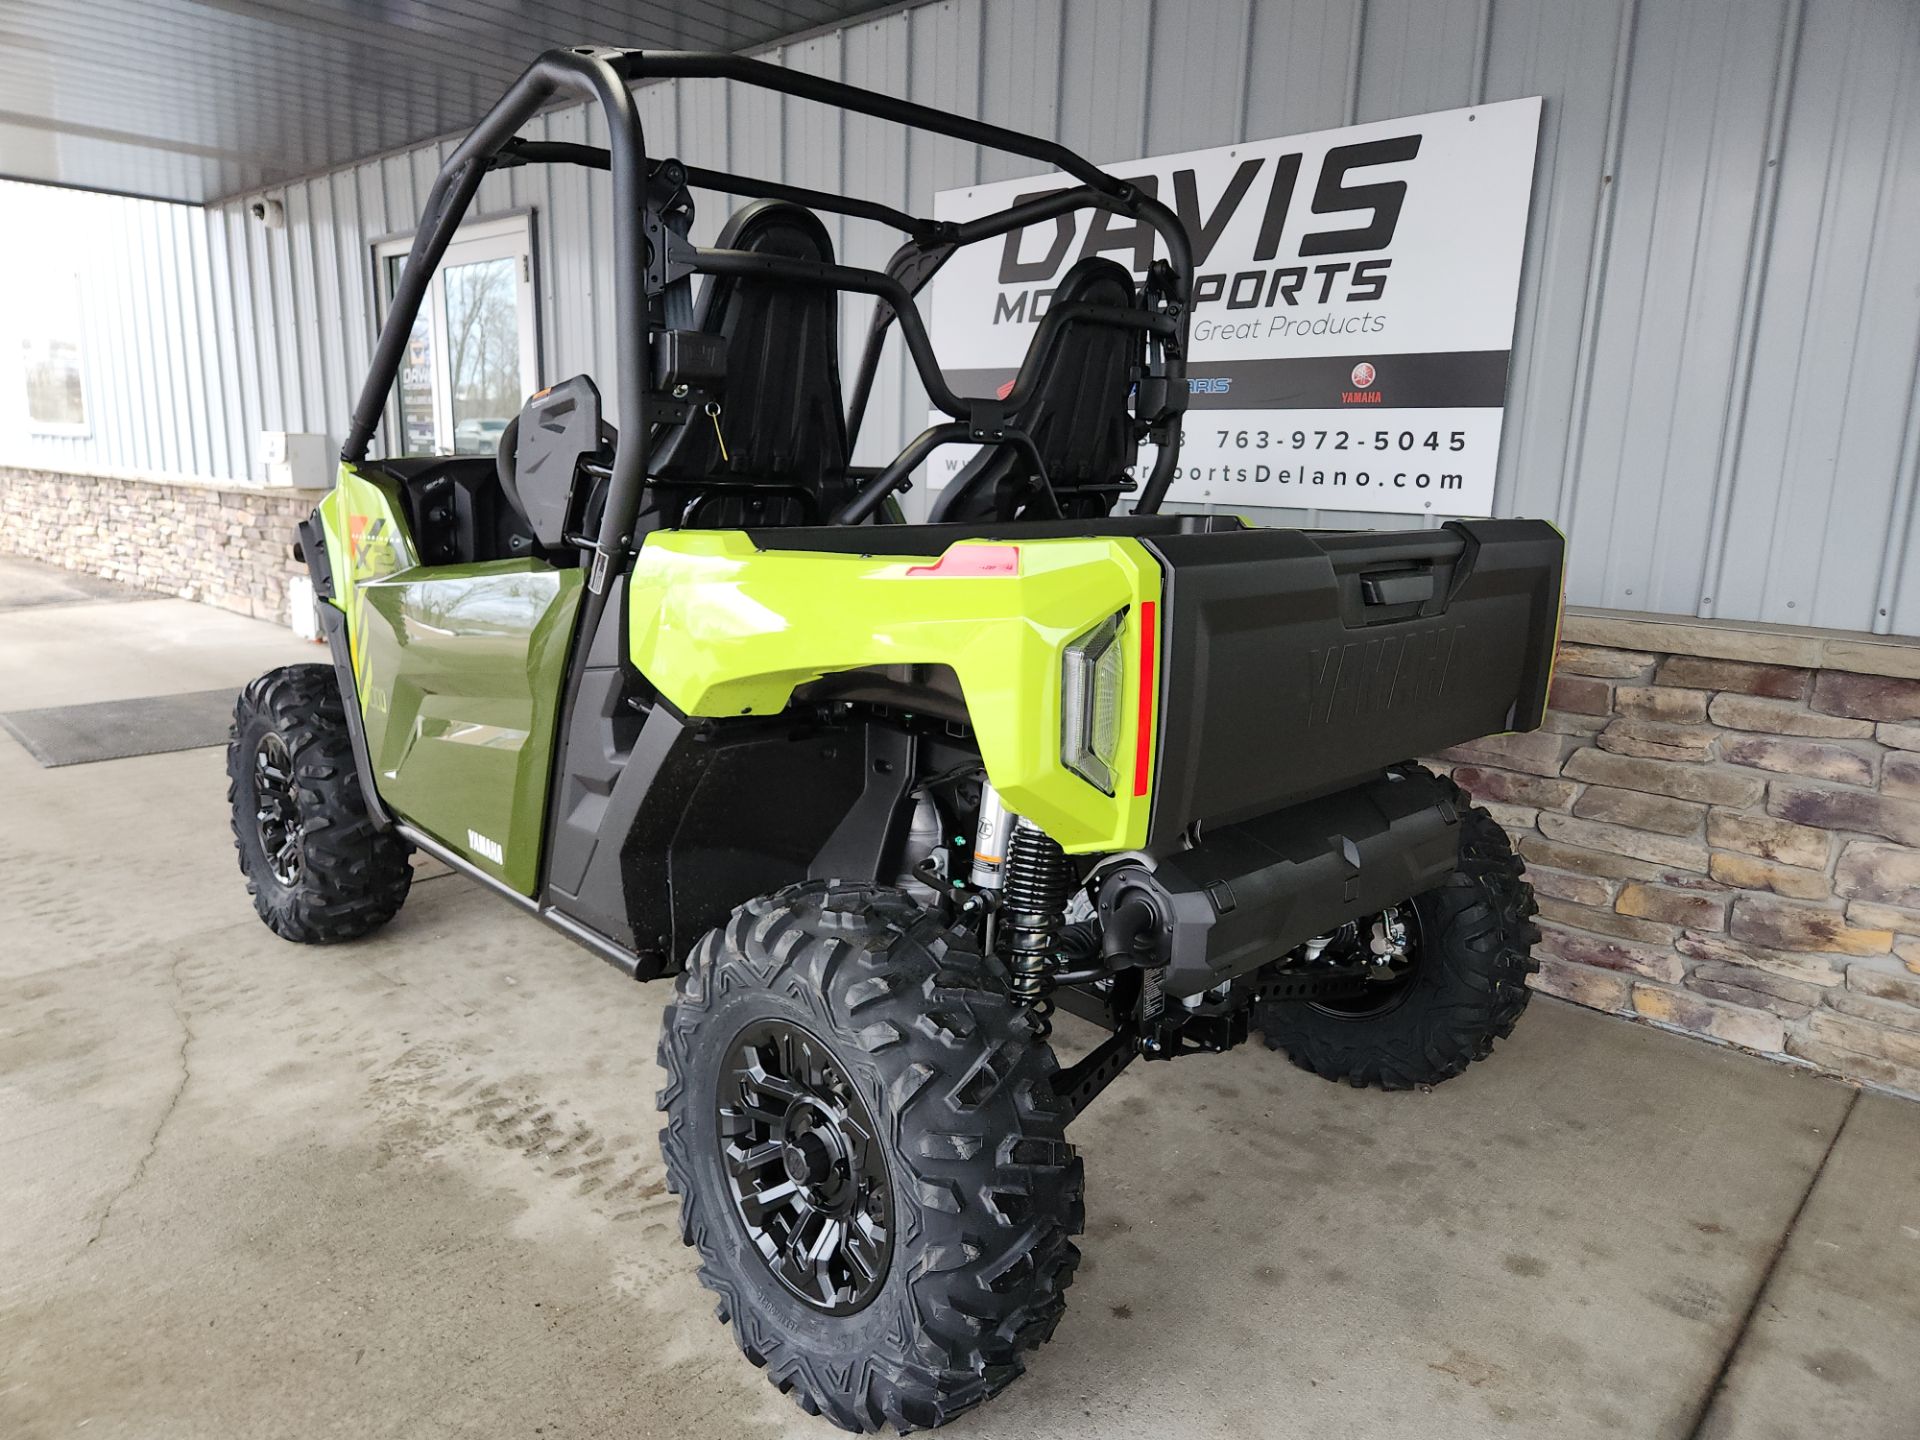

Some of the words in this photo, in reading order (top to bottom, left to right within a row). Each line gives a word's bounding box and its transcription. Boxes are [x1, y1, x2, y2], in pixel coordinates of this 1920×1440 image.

[998, 134, 1423, 284] DAVIS
[1194, 320, 1262, 341] Great
[1268, 312, 1386, 338] Products
[1342, 391, 1381, 404] YAMAHA
[1217, 430, 1465, 451] 763-972-5045
[467, 828, 504, 866] YAMAHA
